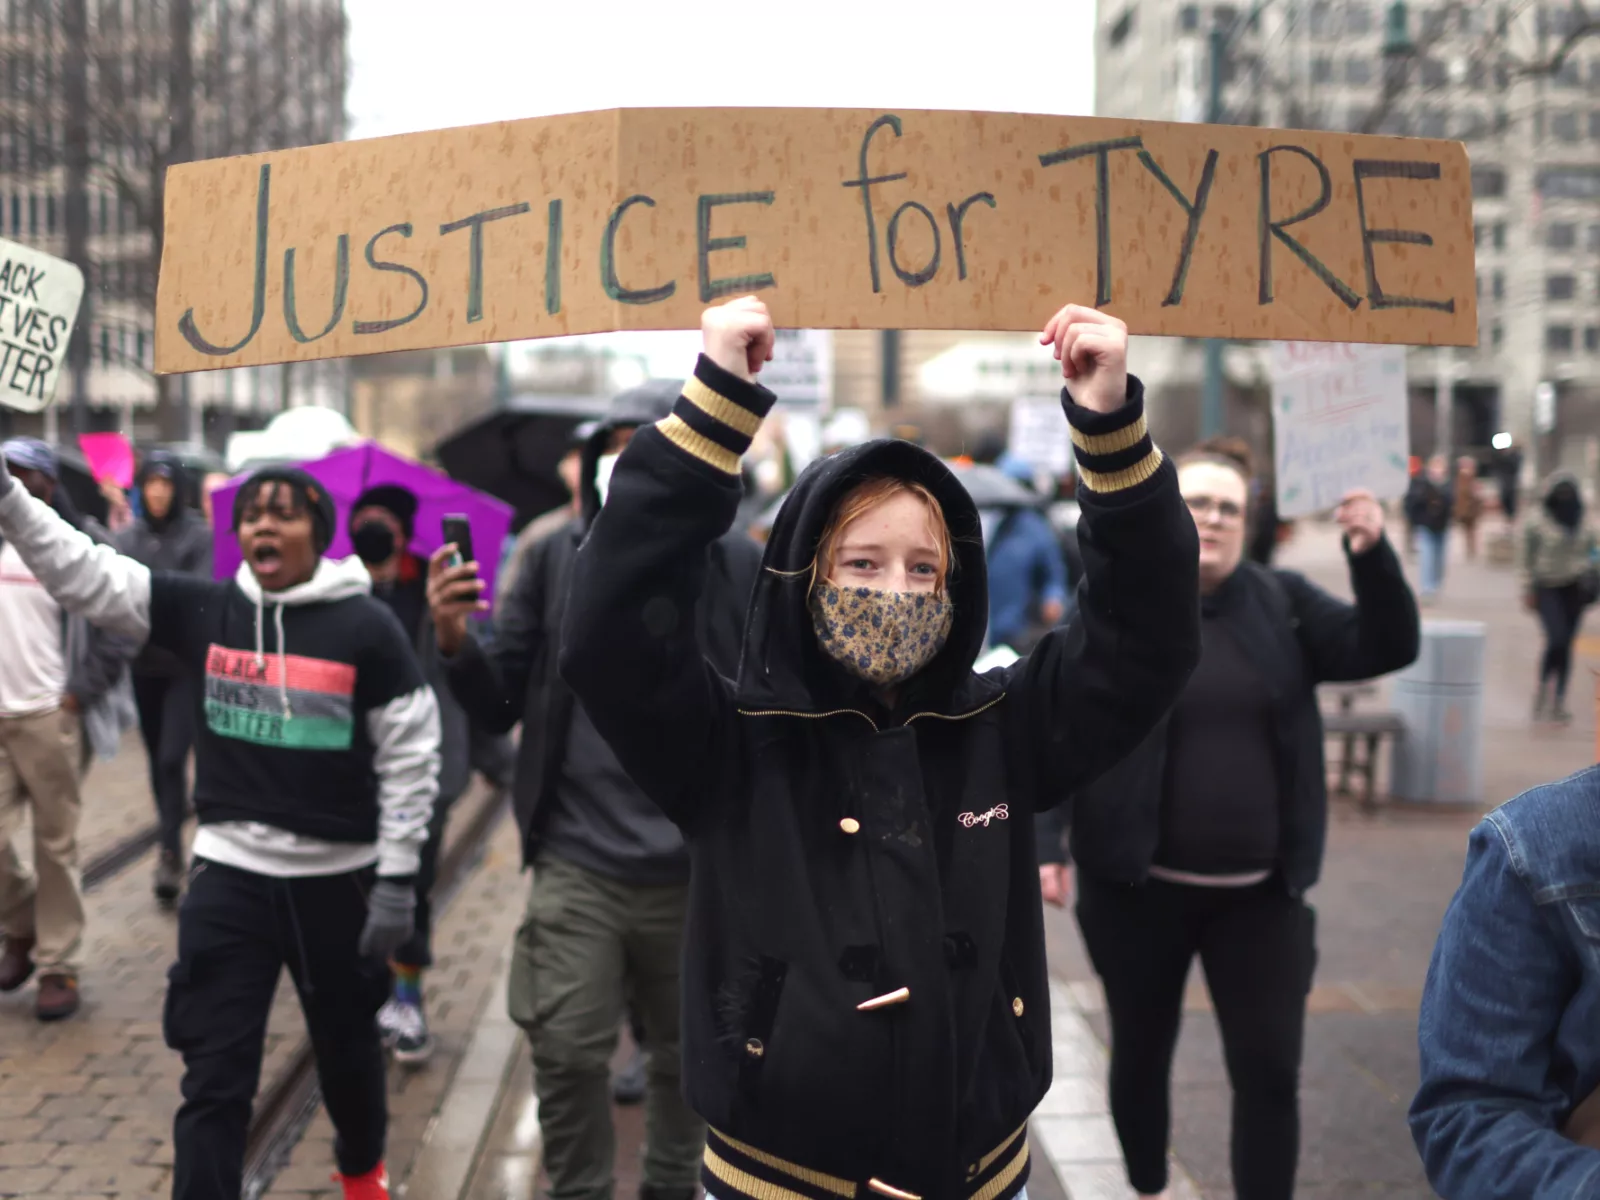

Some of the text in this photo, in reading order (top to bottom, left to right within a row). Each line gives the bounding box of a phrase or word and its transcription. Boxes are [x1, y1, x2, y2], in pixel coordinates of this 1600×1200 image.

[178, 114, 1455, 356] JUSTICE for TYRE
[211, 651, 268, 682] BLACK
